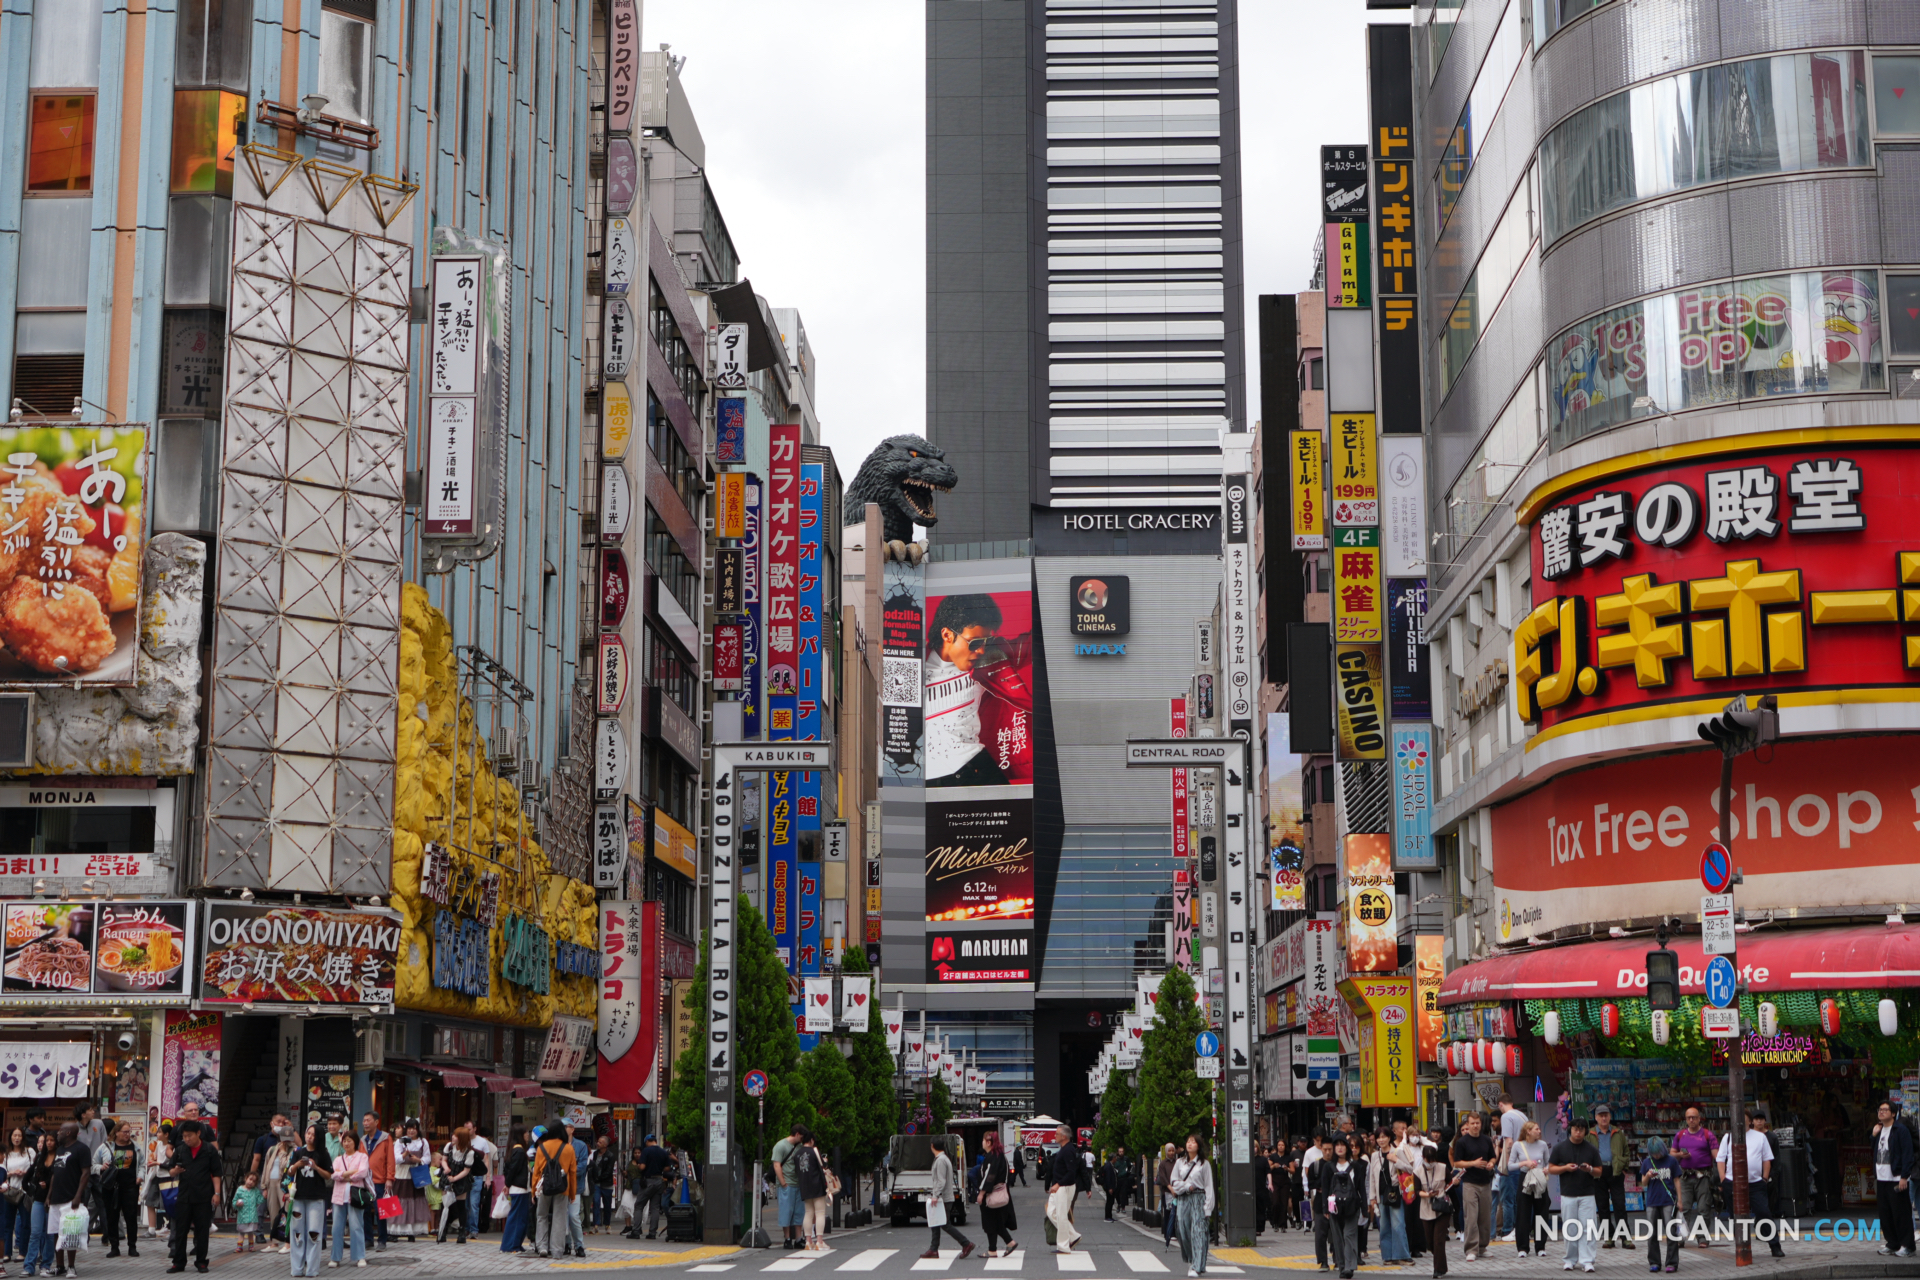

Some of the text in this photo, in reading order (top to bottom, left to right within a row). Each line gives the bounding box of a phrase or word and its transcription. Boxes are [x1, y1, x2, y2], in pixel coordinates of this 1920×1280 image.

[1341, 227, 1356, 289] Garam
[1333, 294, 1366, 304] ガラム
[455, 310, 474, 352] 猛烈に
[611, 314, 624, 354] ヤキトリ
[1592, 293, 1791, 358] Tax Free
[724, 334, 740, 376] ダーツ
[1623, 330, 1749, 382] Sop
[607, 362, 626, 373] 6F
[181, 375, 211, 407] 光
[608, 402, 629, 441] 虎の子
[717, 408, 743, 460] 海の家
[446, 427, 456, 477] チキン酒場
[606, 447, 620, 455] 4F
[1341, 419, 1358, 479] 生ビール
[1298, 437, 1311, 486] 生ビール
[75, 438, 127, 552] あー。
[441, 481, 459, 501] 光
[1335, 484, 1375, 498] 199円
[608, 513, 619, 524] 光
[1228, 485, 1246, 534] Booth
[1302, 488, 1314, 531] 199円
[1540, 457, 1867, 581] 驚安の殿堂
[442, 521, 457, 532] 4F
[1063, 513, 1214, 530] HOTEL GRACERY
[769, 435, 795, 653] カラオケ歌広場
[1342, 530, 1370, 546] 4F
[39, 501, 85, 600] 猛烈に
[1340, 552, 1374, 613] 麻雀
[722, 603, 734, 611] 5F
[1232, 550, 1244, 664] ネットカフェ & カプセル
[1077, 614, 1105, 623] TOHO
[1077, 623, 1116, 632] CINEMAS
[1338, 617, 1370, 627] スリー
[889, 639, 917, 648] Shinjuku
[891, 630, 907, 639] Map
[1338, 628, 1379, 639] ファイブ
[1074, 643, 1126, 655] IMAX
[1200, 628, 1209, 662] 東京ビル
[606, 646, 618, 704] お好み焼き
[720, 679, 734, 689] 4F
[1235, 675, 1246, 711] 8F 5F
[1337, 650, 1384, 753] CASINO
[772, 711, 791, 727] 薬
[1012, 711, 1027, 755] 伝説が
[997, 727, 1010, 770] 始まる
[1132, 748, 1225, 757] CENTRAL ROAD
[29, 791, 96, 804] MONJA
[602, 789, 614, 797] 1F
[1402, 773, 1415, 820] STAGE
[1413, 774, 1425, 812] IDOL
[599, 812, 616, 820] 新宿
[1547, 783, 1882, 867] Tax Free Shop
[598, 820, 616, 867] かっぱ
[1404, 835, 1426, 850] 5F
[926, 838, 1033, 876] Michael
[85, 862, 140, 876] とらそば
[599, 872, 614, 881] B1
[993, 863, 1029, 874] マイケル
[963, 882, 997, 893] 6.12 fri
[1350, 875, 1394, 887] ソフトクリーム
[774, 860, 788, 935] Tax Free Shop
[1359, 894, 1386, 906] 食べ
[9, 907, 50, 926] そば
[102, 906, 166, 924] らーめん
[711, 795, 732, 1043] GODZILLA ROAD
[1227, 813, 1245, 1023] ゴジラロード
[1359, 907, 1386, 920] 放題
[1511, 908, 1542, 927] Don Quijote
[8, 928, 39, 938] Soba
[103, 929, 144, 939] Ramen
[209, 918, 400, 953] OKONOMIYAKI
[626, 904, 639, 957] 大衆酒場
[603, 910, 625, 1000] トラノコ
[961, 938, 1028, 957] MARUHAN
[218, 949, 383, 987] お好み焼き
[1712, 959, 1726, 968] 7-20
[1314, 963, 1328, 992] 九十九
[1617, 968, 1648, 988] Do
[1711, 969, 1723, 1000] P
[1364, 984, 1409, 997] カラオケ
[168, 1014, 218, 1035] お好み焼き
[1385, 1009, 1403, 1020] 24H
[5, 1052, 51, 1060] スタミナ一番
[162, 1039, 179, 1120] 食べ飲み放題
